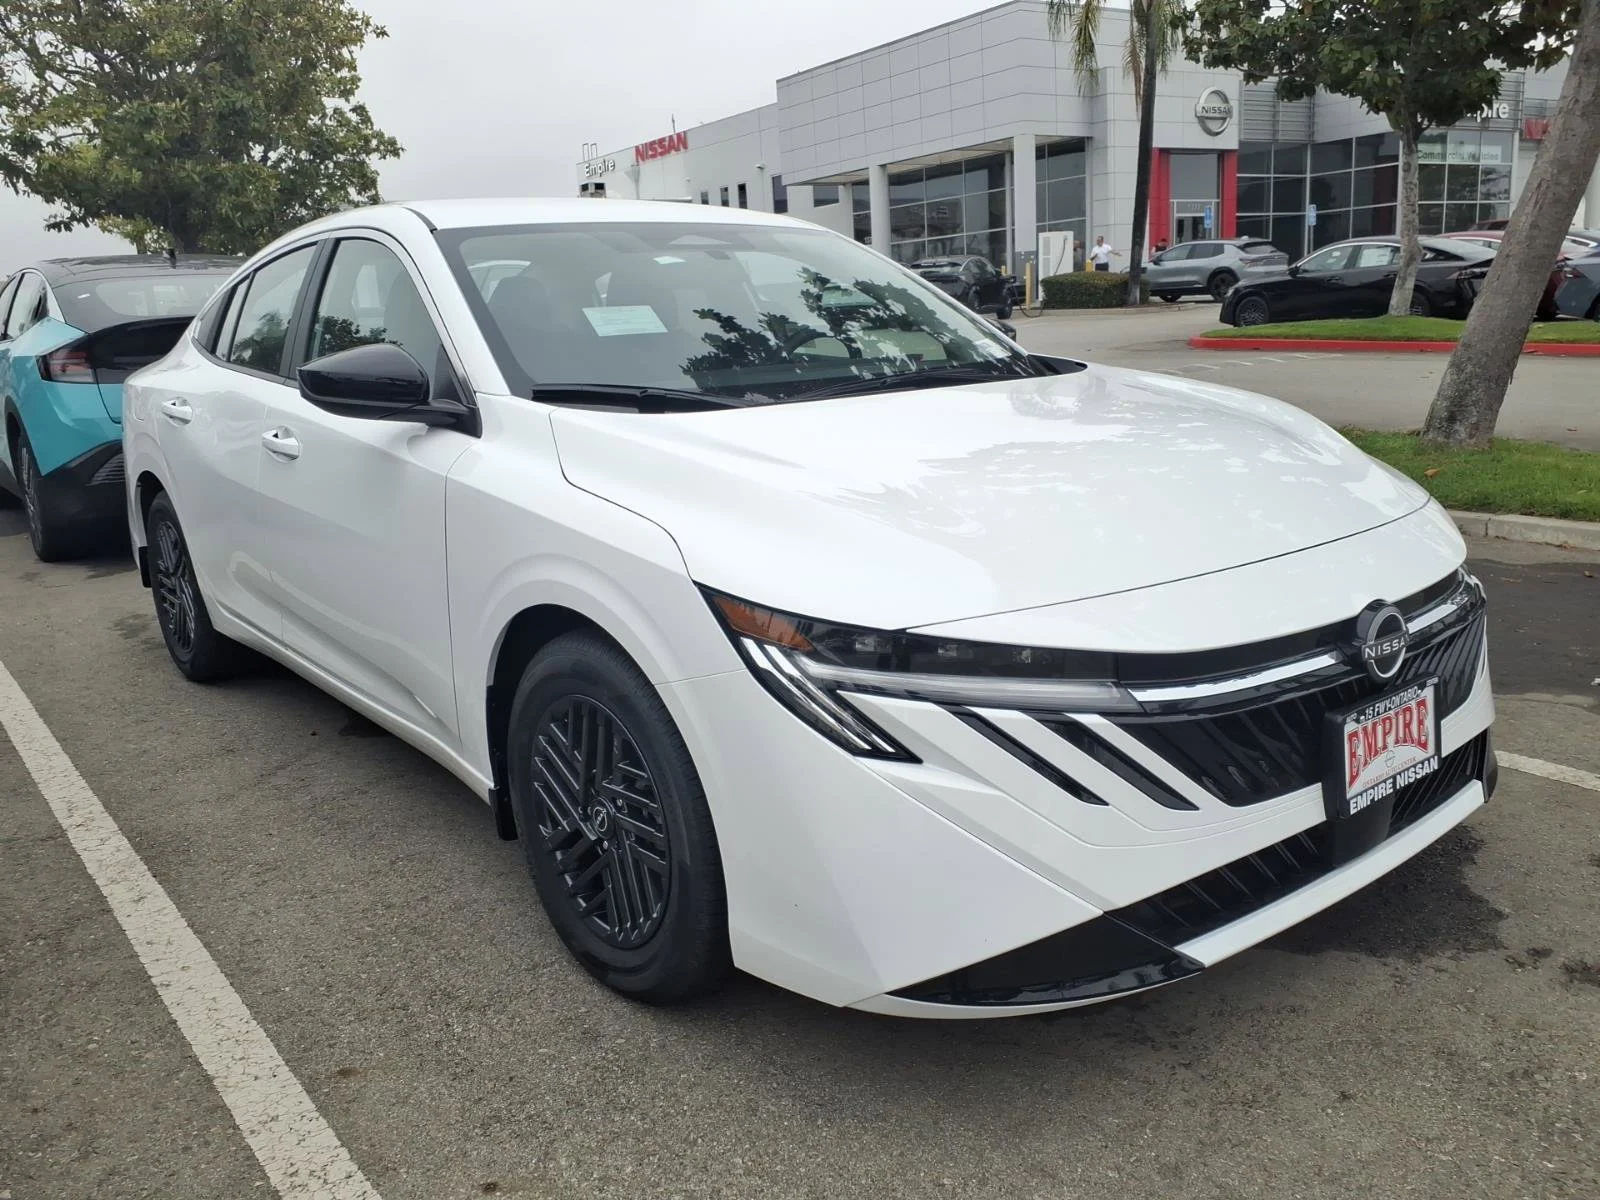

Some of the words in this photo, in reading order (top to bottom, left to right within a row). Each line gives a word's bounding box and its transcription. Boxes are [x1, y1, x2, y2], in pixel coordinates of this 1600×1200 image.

[584, 157, 616, 178] Empire
[634, 130, 688, 162] NISSAN
[1346, 696, 1428, 791] EMPIRE
[1350, 778, 1394, 816] EMPIRE
[1396, 755, 1438, 789] NISSAN
